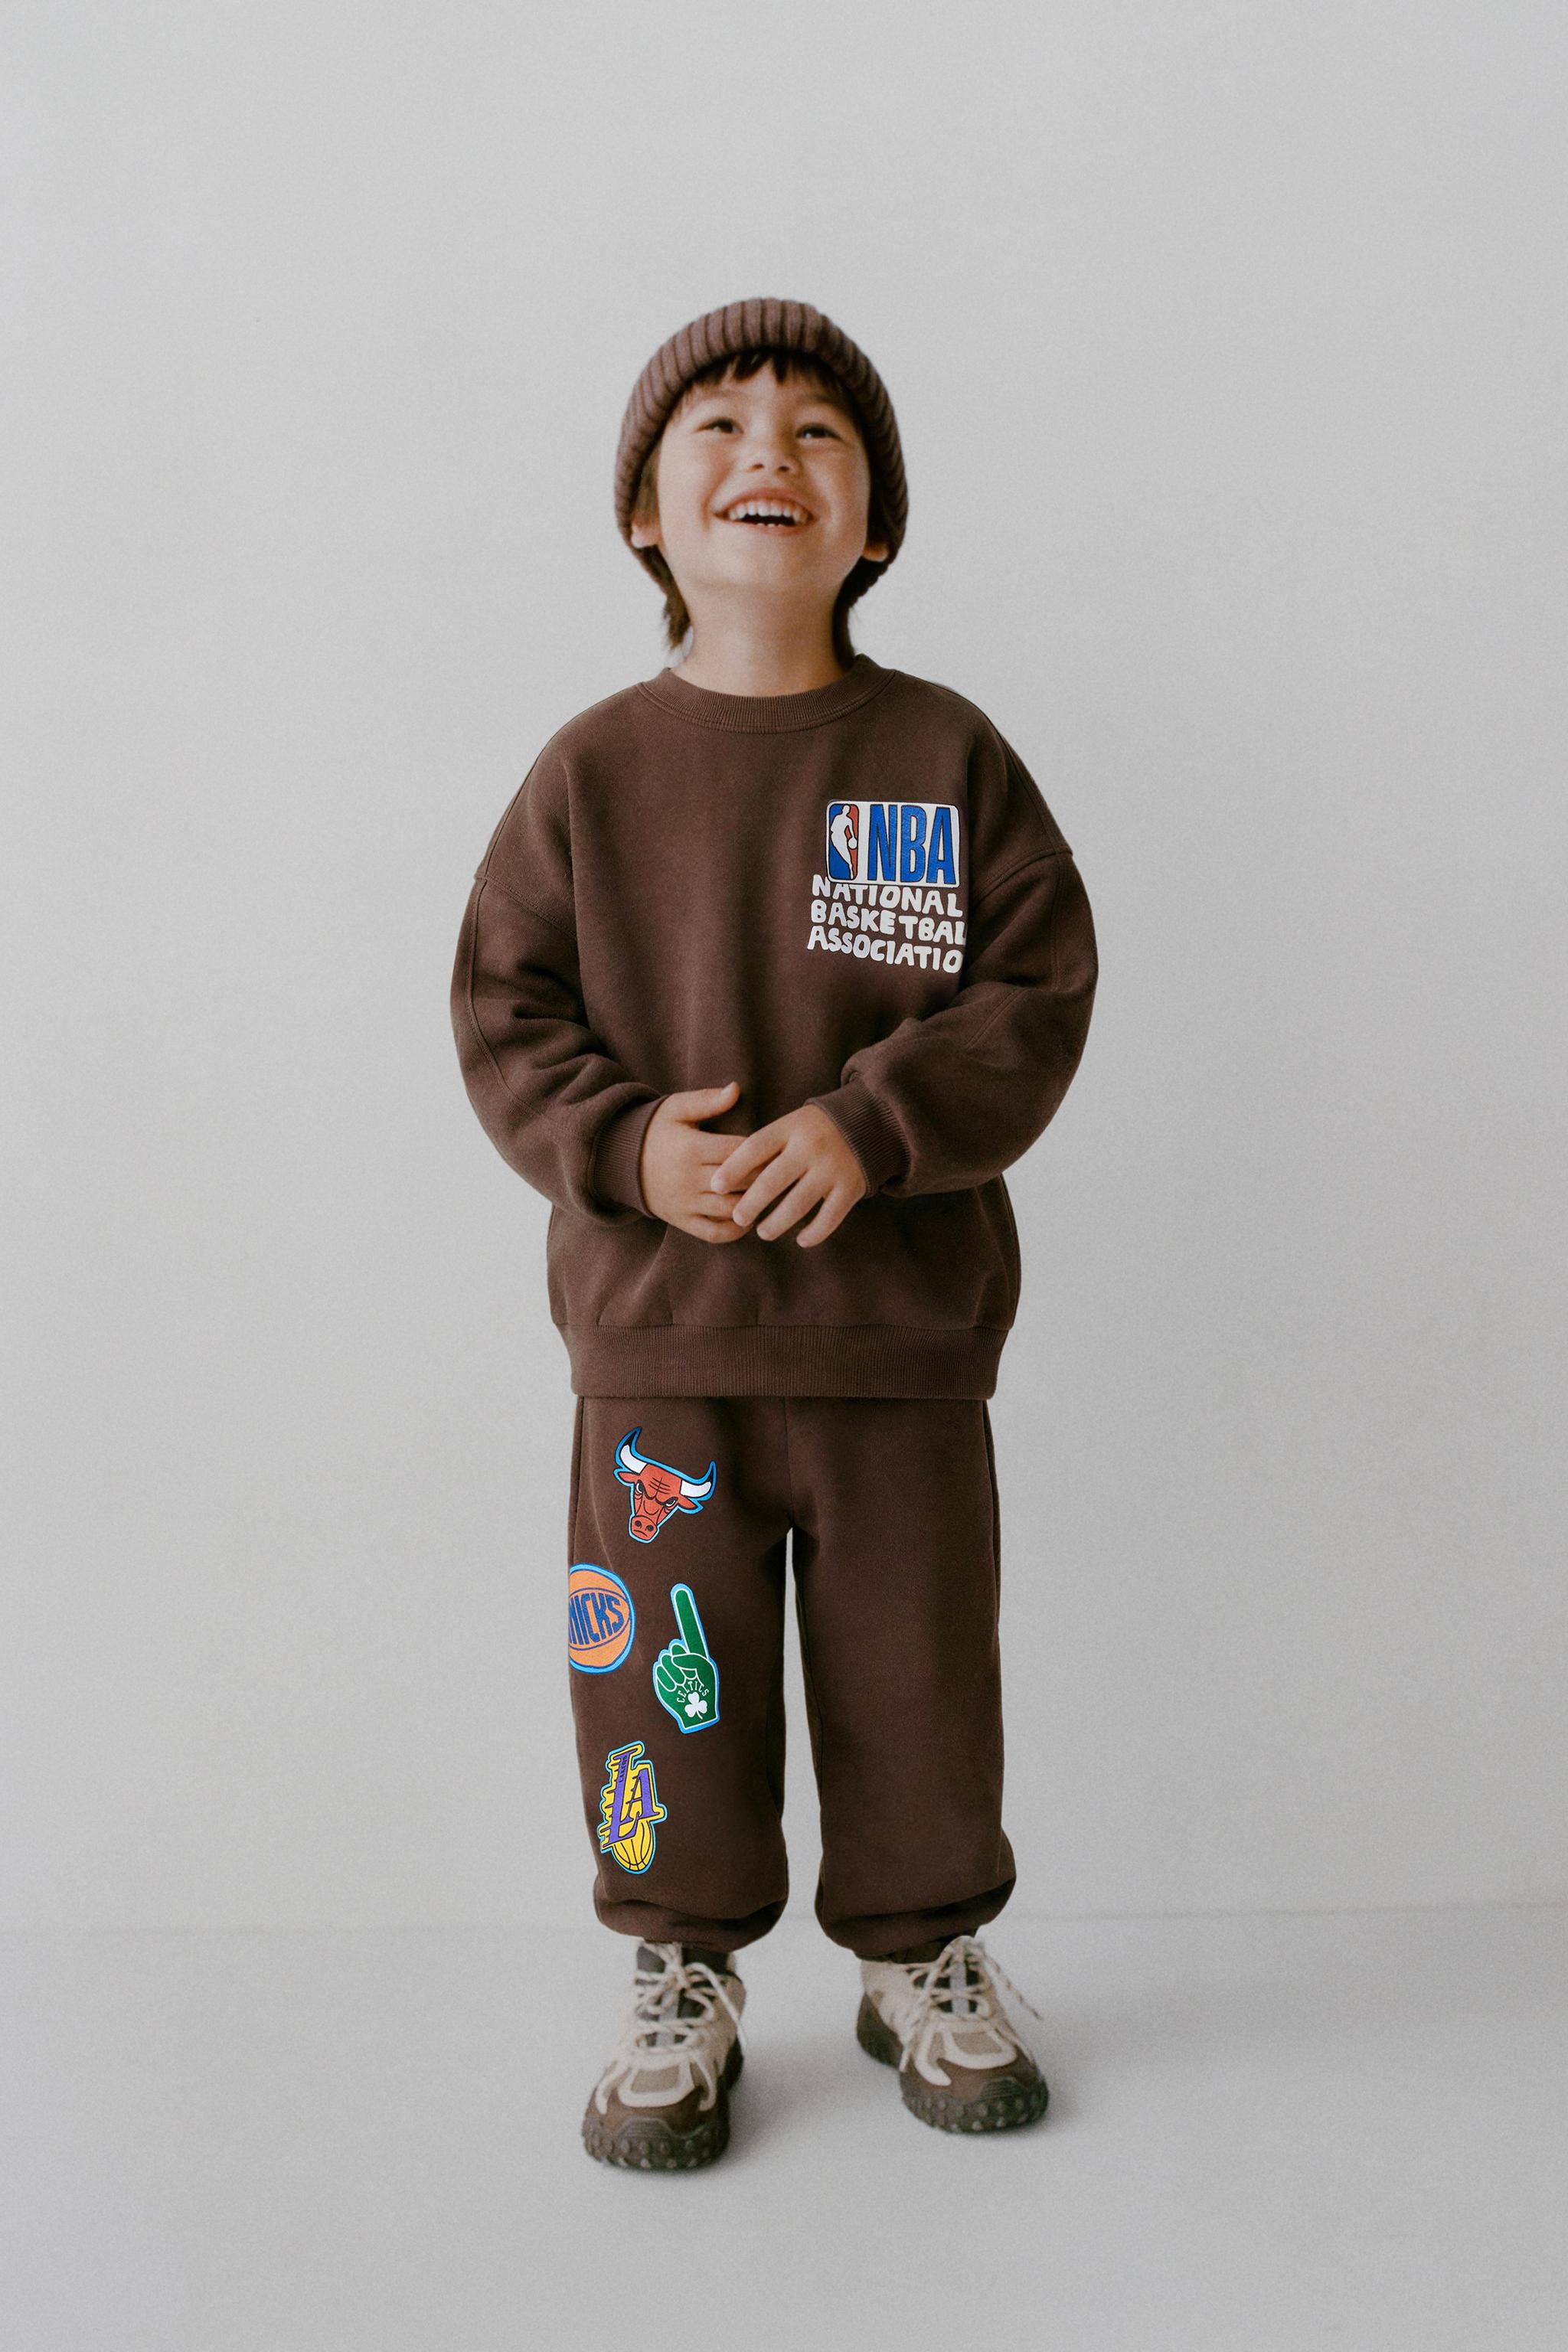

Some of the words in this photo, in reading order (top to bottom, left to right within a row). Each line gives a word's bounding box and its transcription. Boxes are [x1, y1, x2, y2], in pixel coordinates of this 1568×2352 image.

[867, 805, 956, 885] NBA
[812, 874, 963, 917] NATIONAL
[568, 1592, 624, 1645] NICKS
[677, 1681, 709, 1704] CELTICS
[600, 1748, 660, 1847] LA
